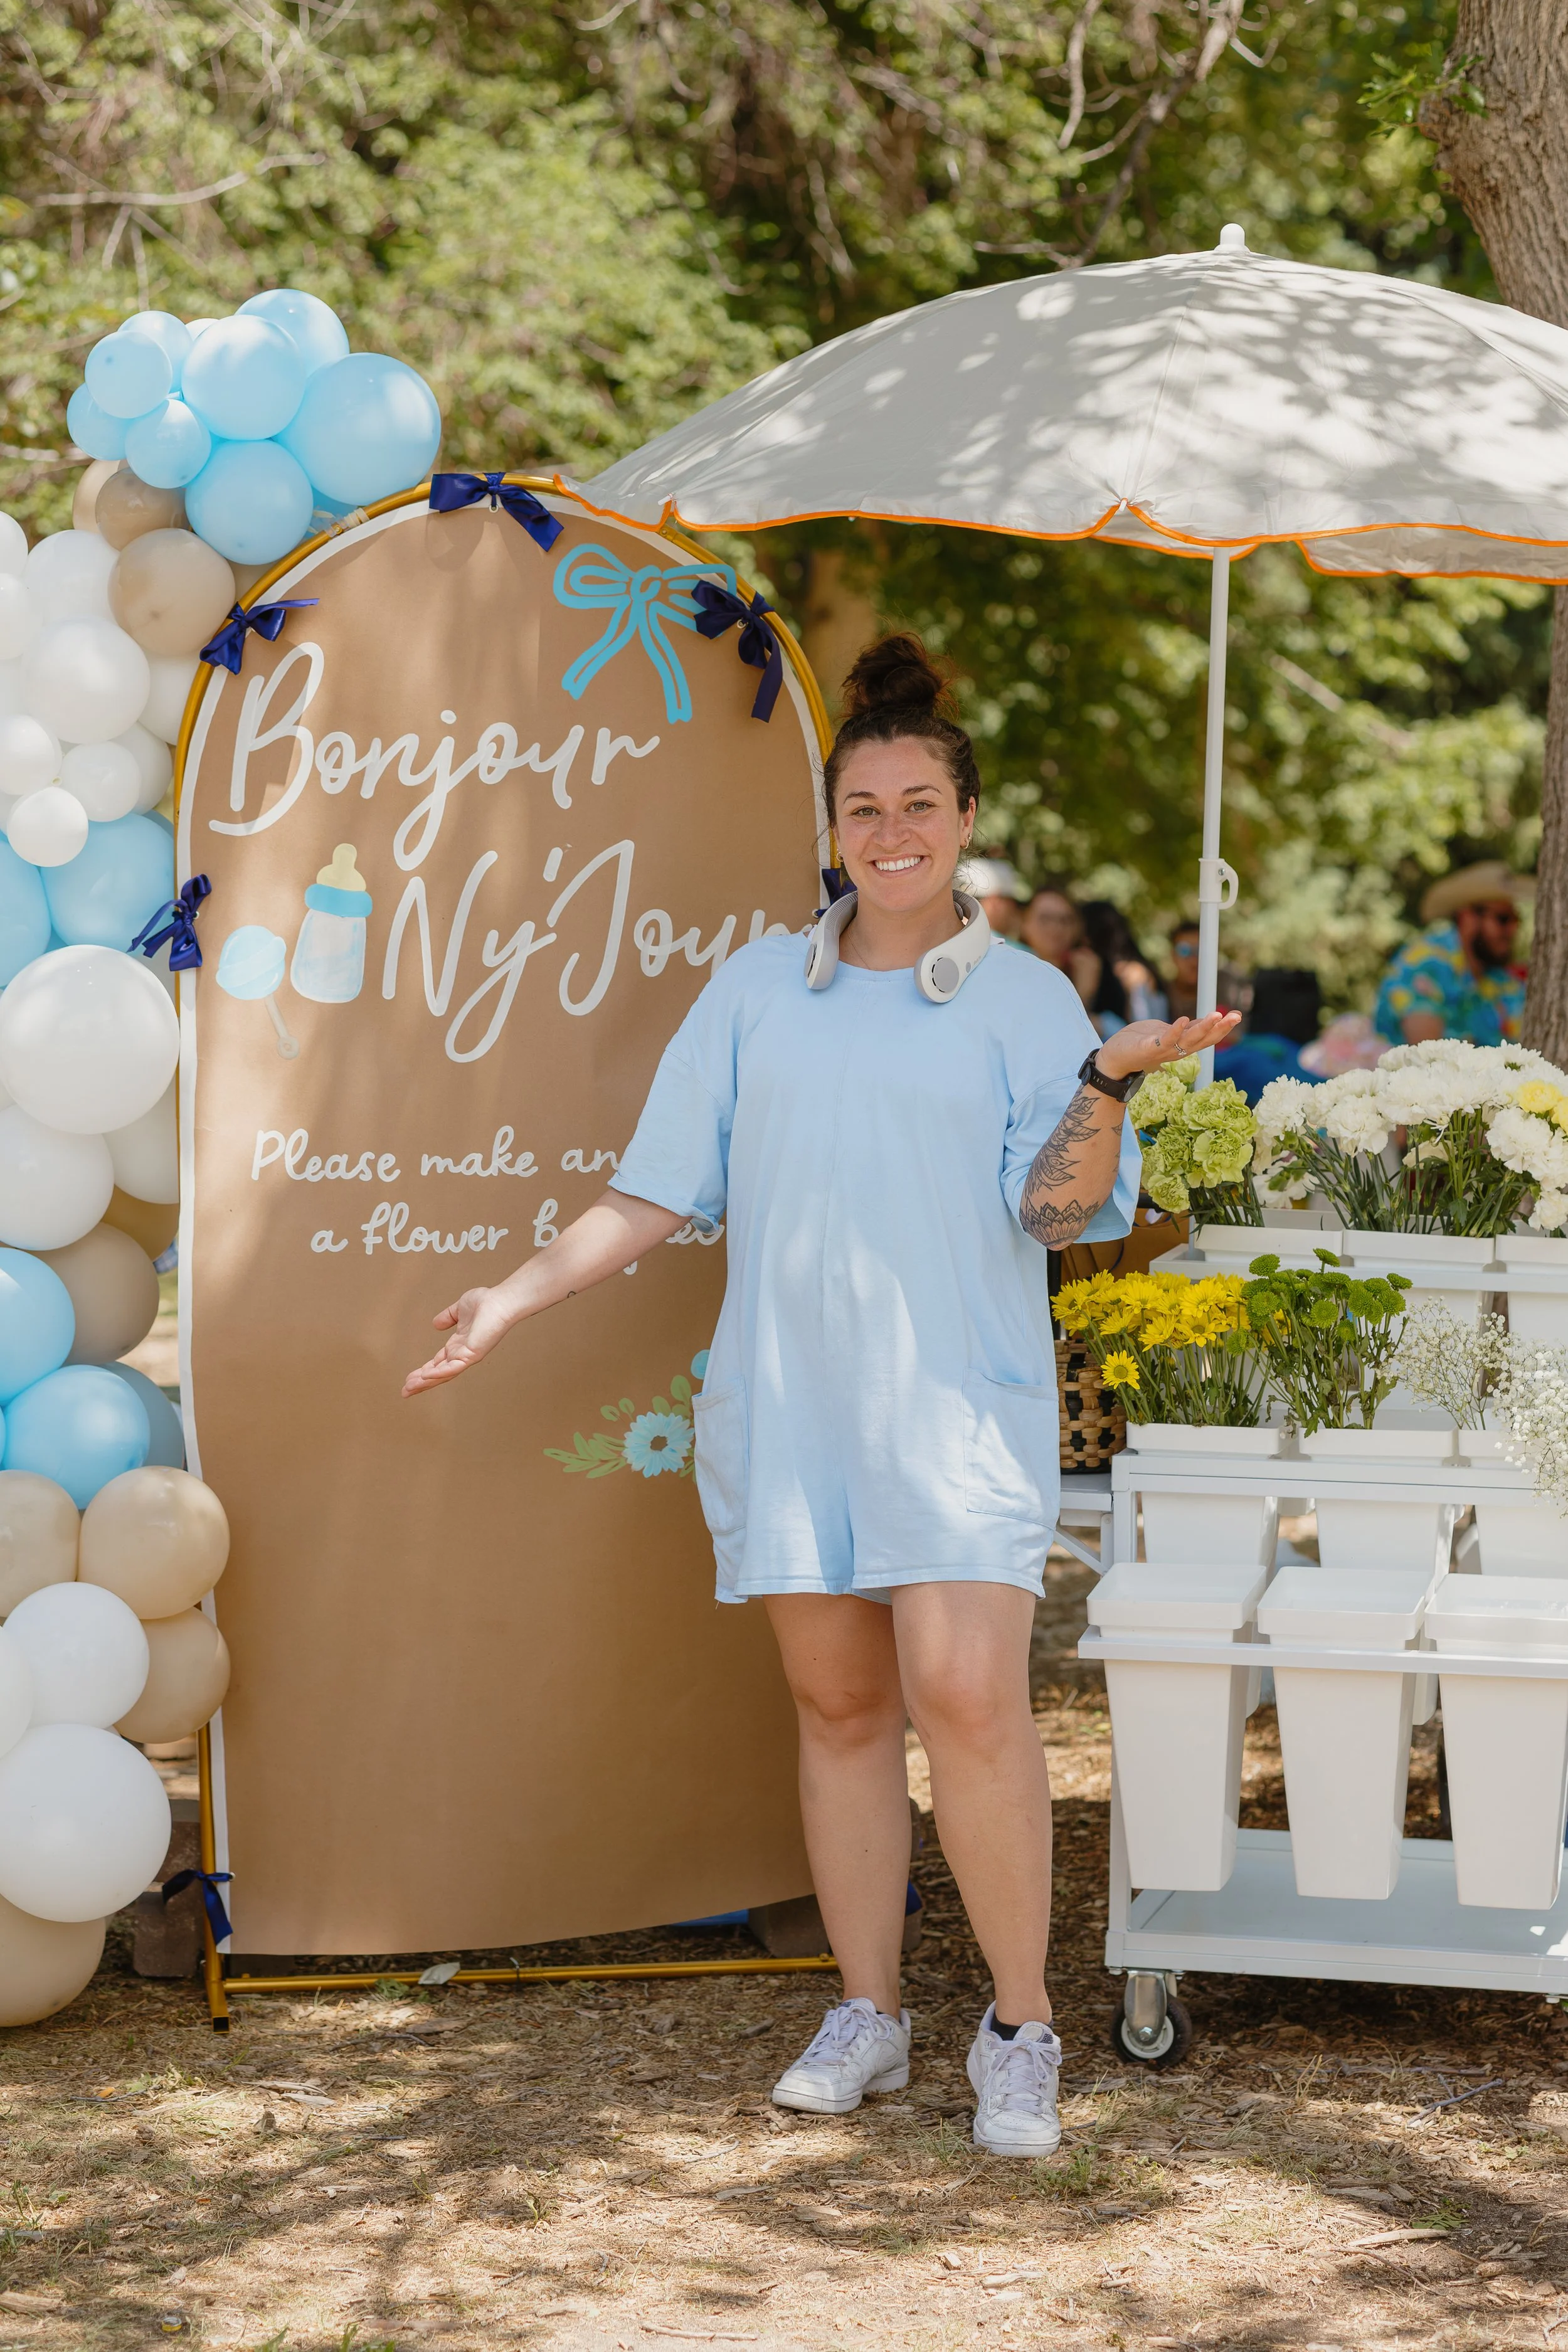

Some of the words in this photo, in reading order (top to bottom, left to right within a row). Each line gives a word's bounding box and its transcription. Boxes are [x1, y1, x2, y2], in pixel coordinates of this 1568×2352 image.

[209, 642, 660, 871] Bonjour
[252, 1129, 400, 1182] Please
[421, 1126, 538, 1177] make
[311, 1230, 349, 1253] a
[361, 1202, 509, 1255] flower
